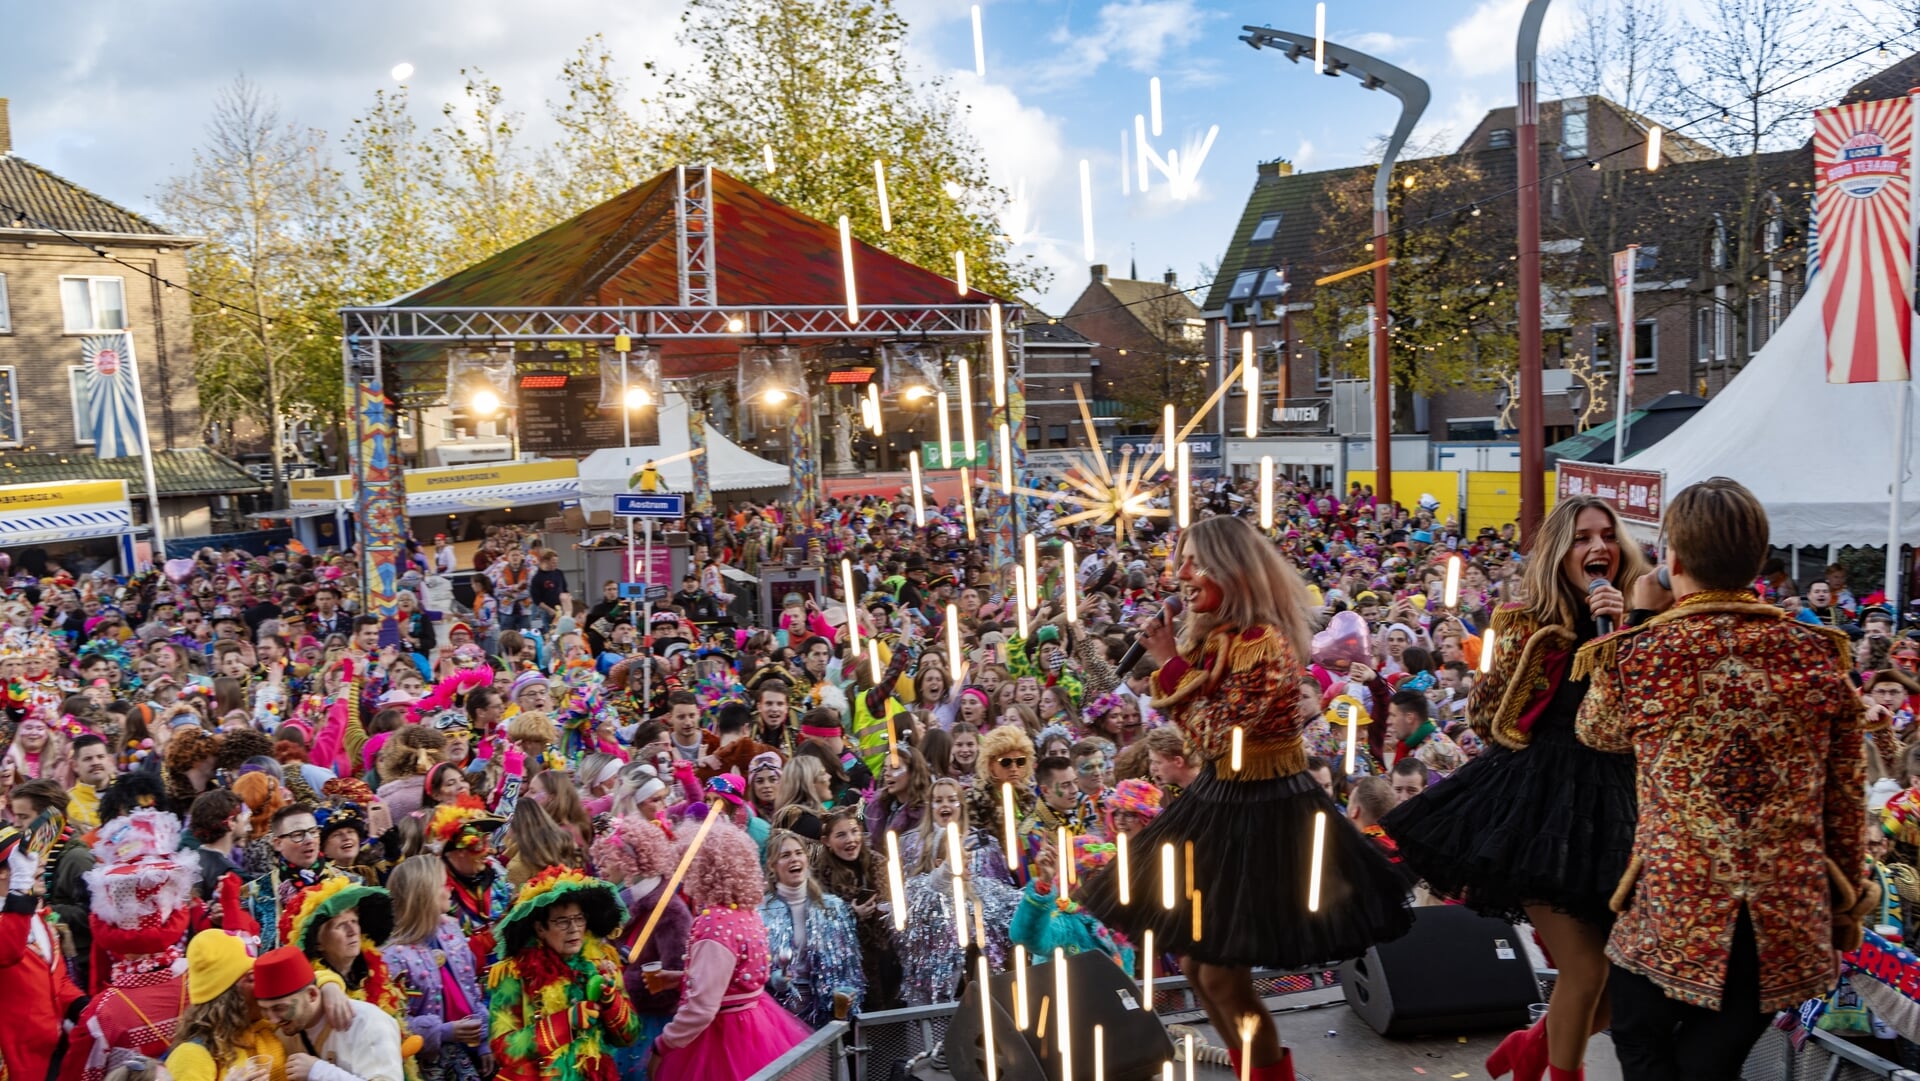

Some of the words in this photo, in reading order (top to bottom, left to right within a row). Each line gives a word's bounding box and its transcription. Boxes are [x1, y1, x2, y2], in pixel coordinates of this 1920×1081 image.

[1272, 407, 1320, 422] MUNTEN
[1136, 441, 1212, 454] TOILTEN
[1629, 484, 1648, 508] BAR
[628, 500, 670, 510] Aostrum
